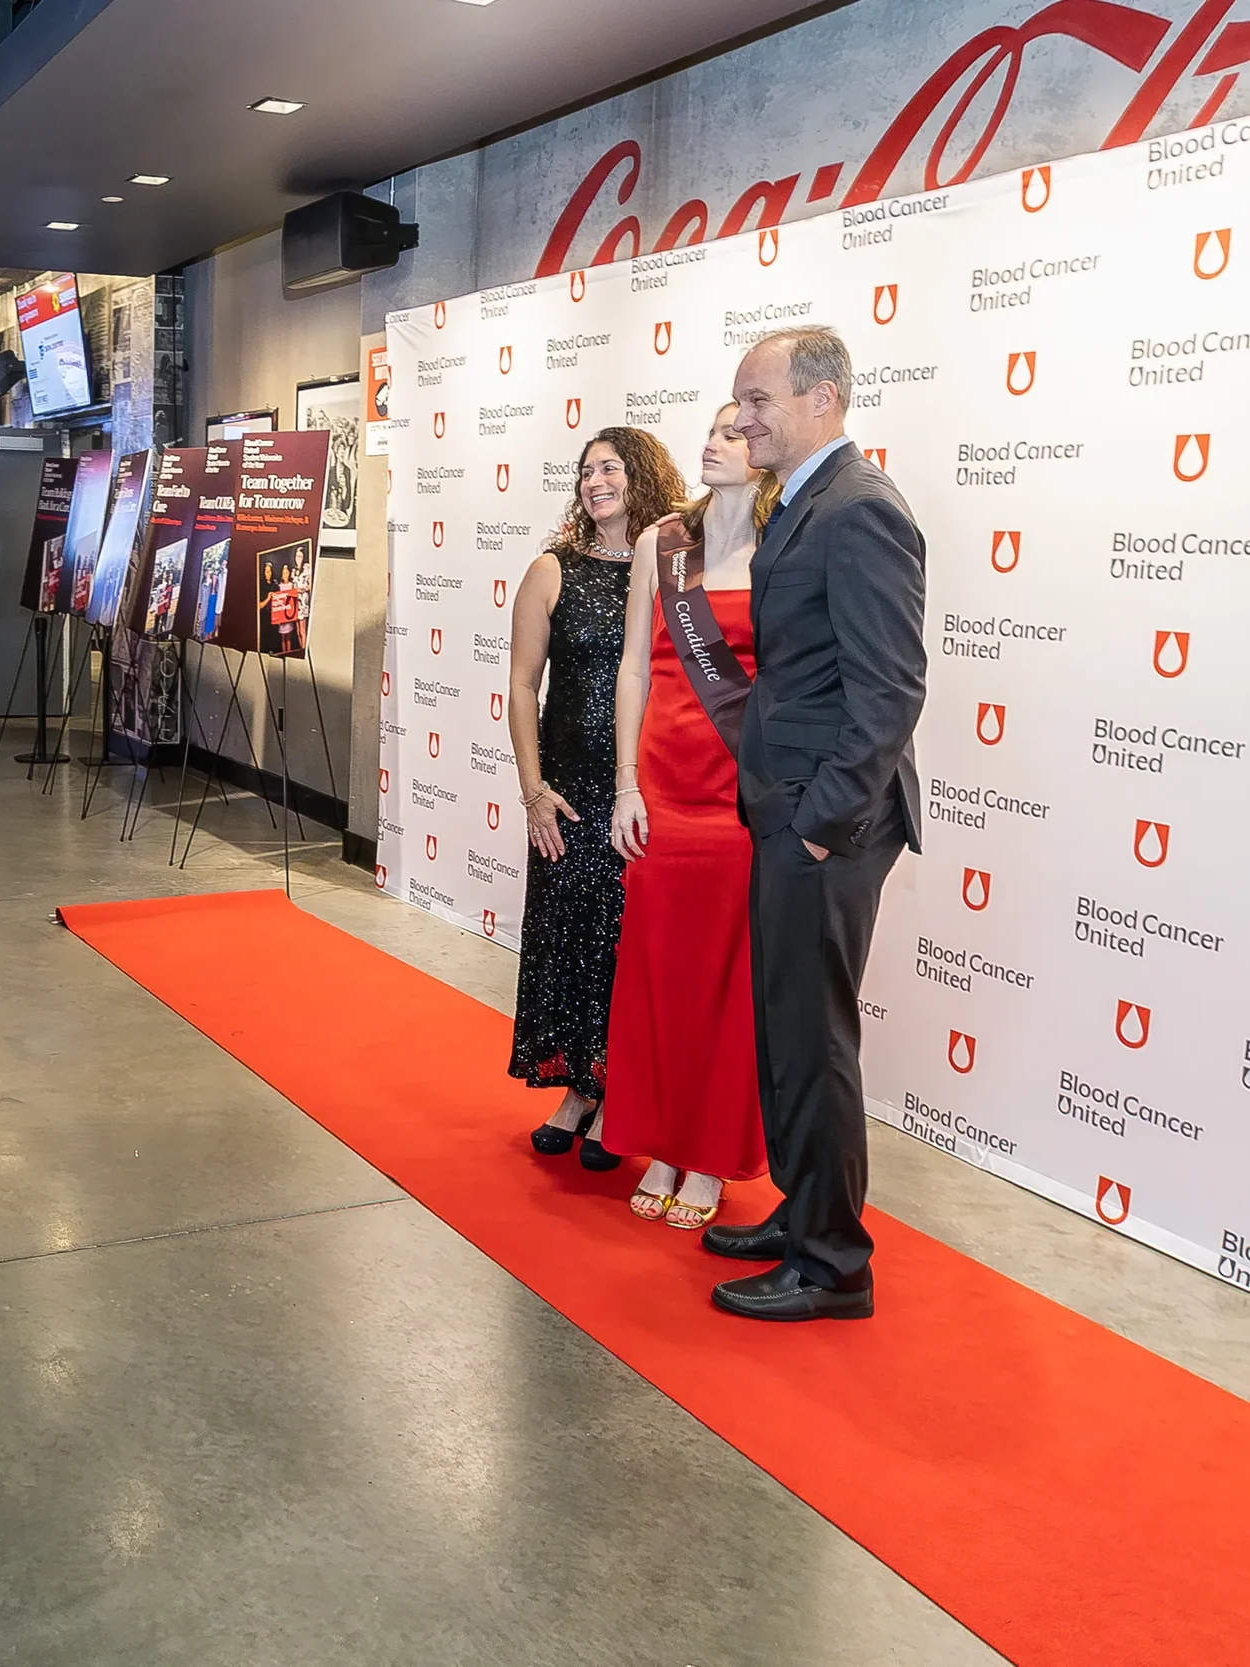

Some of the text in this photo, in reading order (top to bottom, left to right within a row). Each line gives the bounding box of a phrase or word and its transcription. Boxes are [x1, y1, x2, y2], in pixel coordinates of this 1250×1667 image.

[1147, 126, 1216, 163] Blood
[1147, 154, 1224, 190] United
[842, 194, 949, 228] Blood Cancer
[842, 224, 893, 250] United
[632, 249, 707, 274] Blood Cancer
[972, 255, 1101, 288] Blood Cancer
[631, 271, 668, 293] United
[480, 284, 537, 304] Blood Cancer
[970, 285, 1031, 312] United
[480, 303, 509, 320] United
[725, 301, 813, 327] Blood Cancer
[547, 334, 611, 352] Blood Cancer
[1131, 331, 1250, 360] Blood Can
[418, 356, 466, 372] Blood Cancer
[546, 352, 578, 370] United
[418, 372, 442, 387] United
[851, 366, 938, 386] ood Cancer
[1129, 360, 1204, 387] United
[626, 389, 700, 407] Blood Cancer
[850, 389, 882, 409] ited
[479, 404, 534, 420] Blood Cancer
[625, 408, 661, 425] United
[479, 421, 506, 436] United
[958, 441, 1084, 462] Blood Cancer
[417, 466, 465, 479] Blood Cancer
[543, 461, 570, 475] Blood
[956, 466, 1016, 486] United
[240, 474, 314, 493] Team Together
[417, 481, 441, 494] United
[542, 478, 573, 492] United
[238, 493, 305, 510] for Tomorrow
[477, 522, 531, 535] Blood Cancer
[476, 537, 503, 550] United
[1112, 532, 1250, 556] Blood Cance
[1110, 558, 1183, 581] United
[416, 573, 463, 589] Blood Cancer
[416, 588, 439, 602] United
[944, 614, 1067, 642] Blood Cancer
[474, 634, 497, 649] Blood
[675, 600, 721, 682] Candidate
[942, 637, 1001, 660] United
[474, 649, 500, 665] United
[414, 678, 461, 698] Blood Cancer
[414, 692, 437, 707] United
[1094, 718, 1246, 759] Blood Cancer
[471, 742, 515, 765] Blood Canc
[1092, 743, 1163, 774] United
[471, 757, 497, 775] United
[412, 778, 458, 803] Blood Cancer
[412, 792, 435, 810] United
[929, 778, 1050, 819] Blood Cancer
[929, 801, 986, 830] United
[468, 849, 520, 879] Blood Cancer
[468, 864, 493, 884] United
[409, 891, 431, 911] United
[410, 878, 455, 907] Blood Cancer
[1075, 896, 1224, 952] Blood Cancer
[1075, 920, 1144, 958] United
[916, 936, 1034, 989] Blood Cancer
[916, 957, 971, 993] United
[857, 999, 888, 1021] ncer
[1058, 1070, 1204, 1141] Blood Cancer
[1058, 1094, 1125, 1137] United
[901, 1113, 957, 1154] United
[902, 1091, 1017, 1155] Blood Cancer
